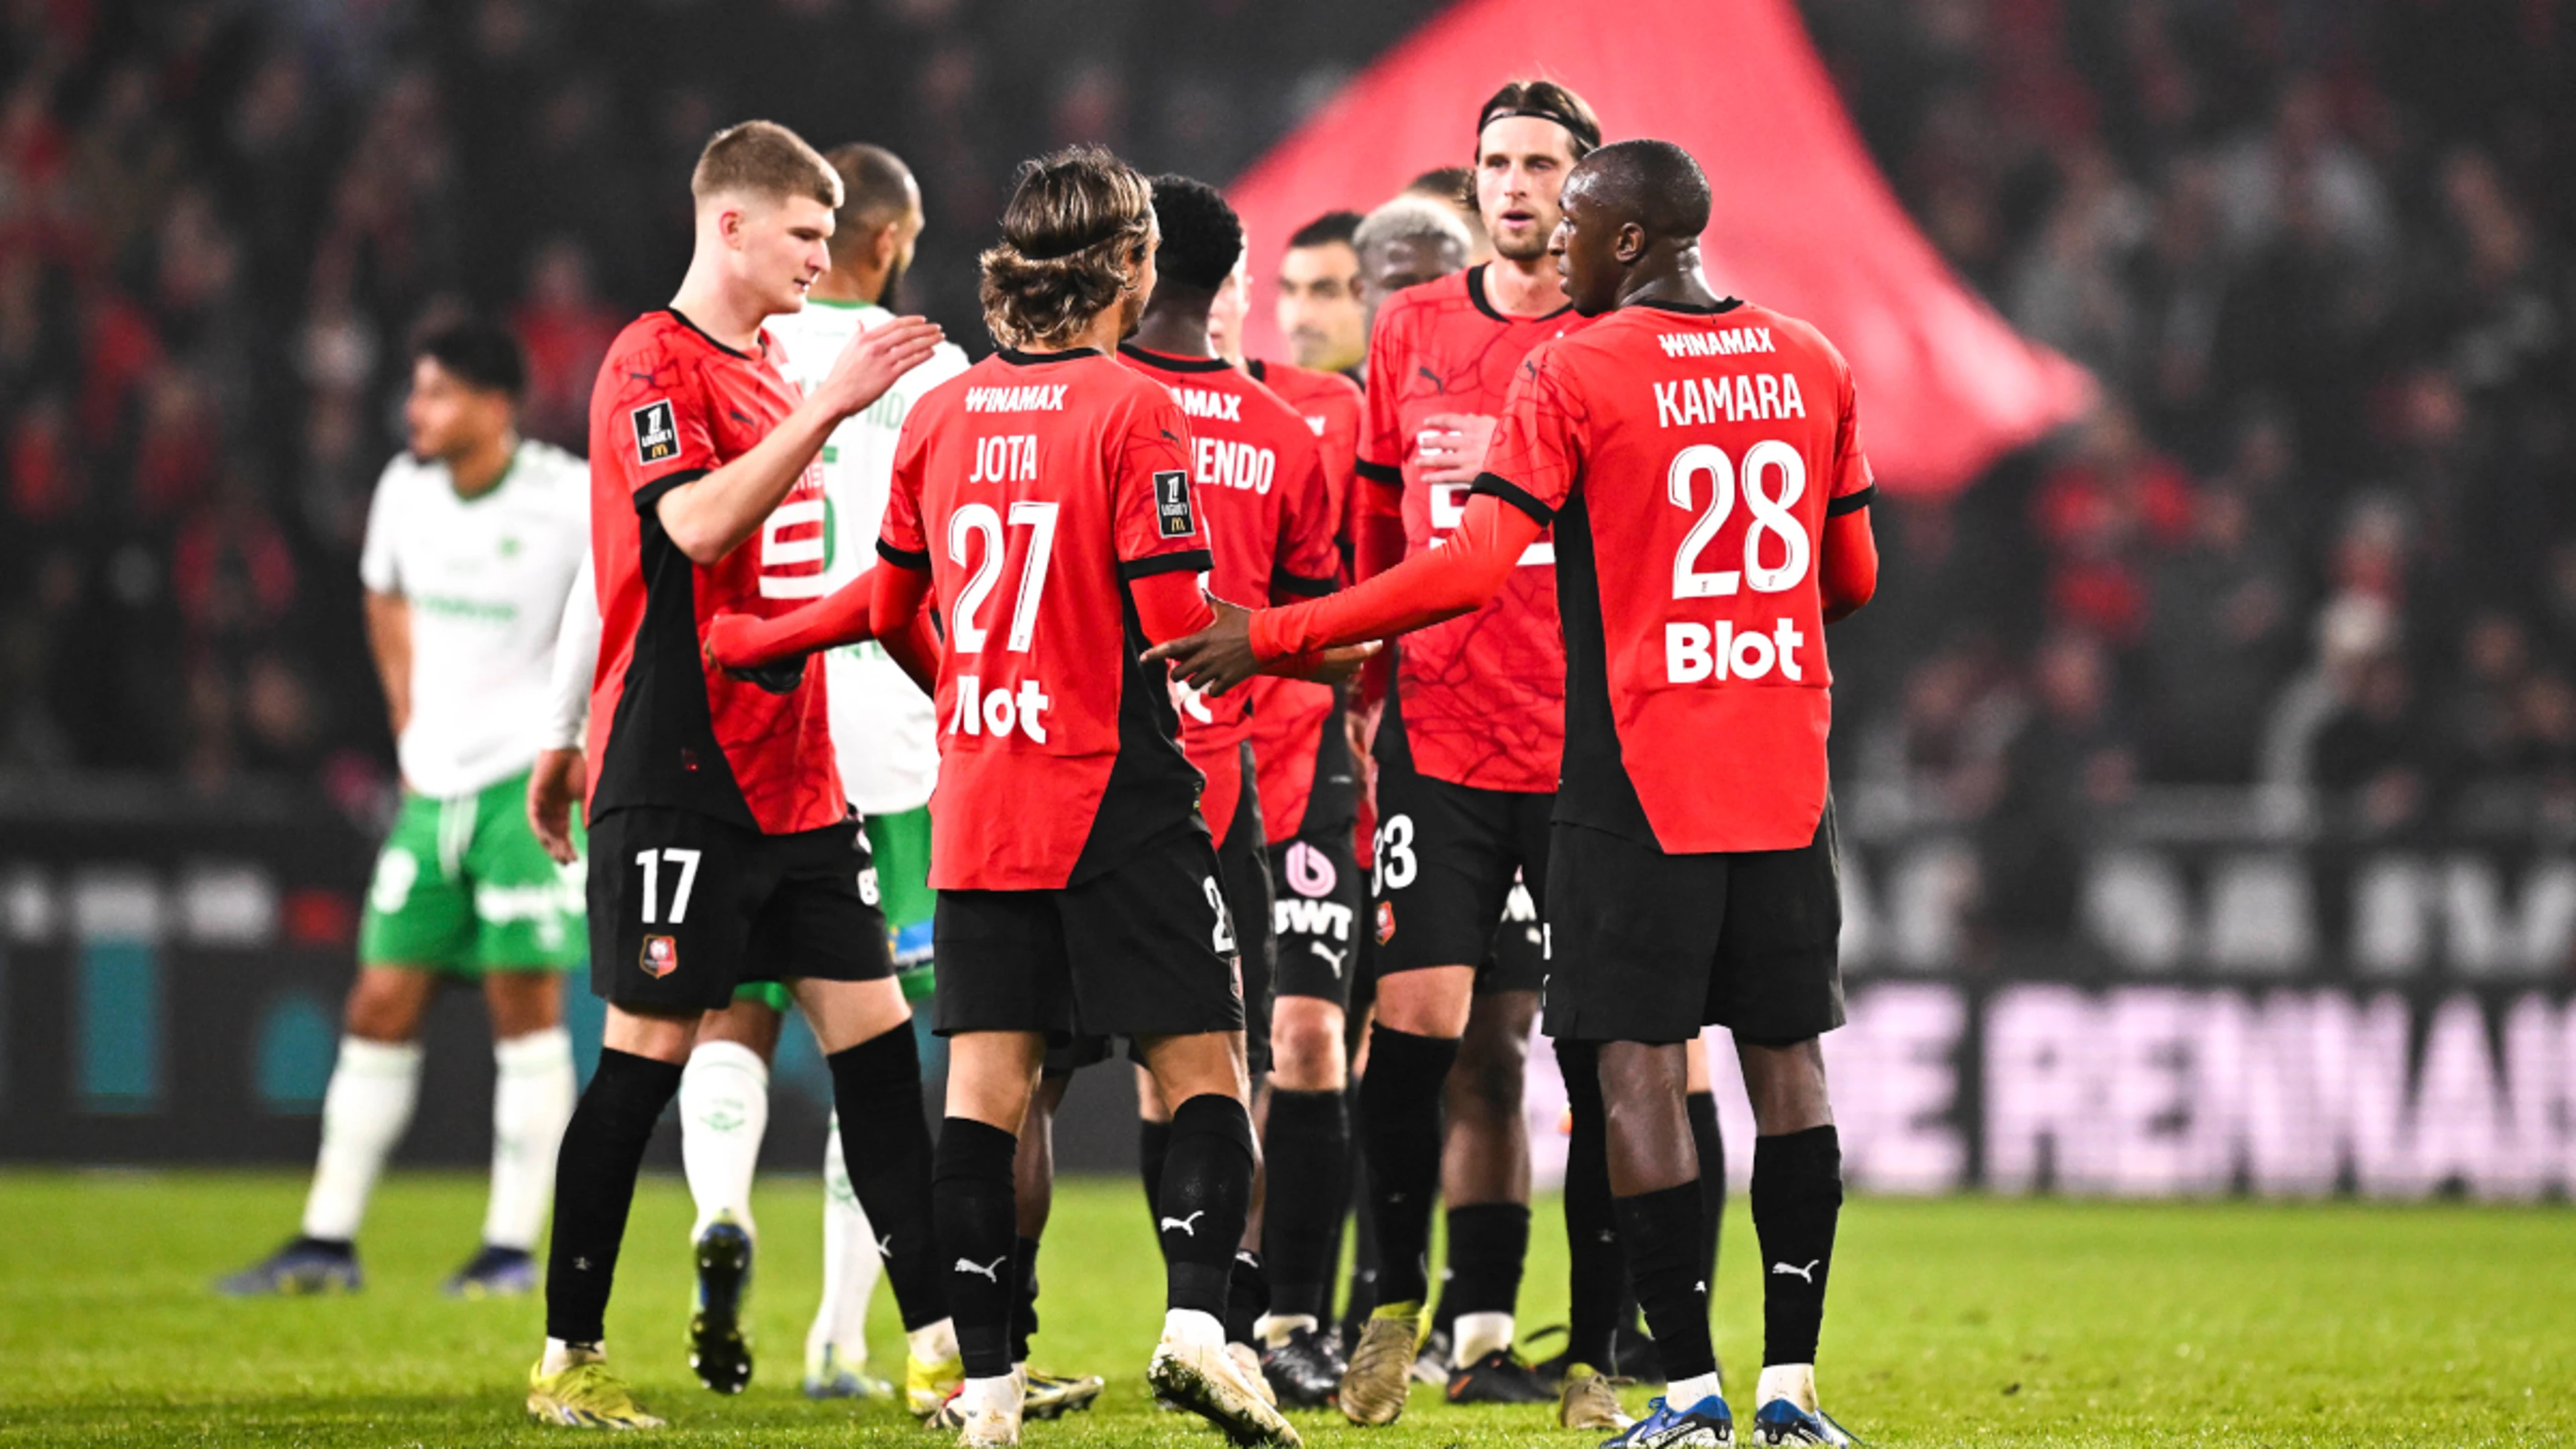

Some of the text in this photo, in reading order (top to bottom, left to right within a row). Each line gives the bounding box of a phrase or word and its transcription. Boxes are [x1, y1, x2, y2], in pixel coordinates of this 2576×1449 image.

[1657, 328, 1776, 357] WINAMAX
[965, 384, 1069, 413] WINAMAX
[1653, 373, 1806, 428] KAMARA
[969, 434, 1037, 483] JOTA
[1191, 437, 1275, 494] ENDO
[1668, 440, 1810, 599] 28
[948, 500, 1059, 653] 27
[1666, 618, 1803, 683] Blot
[635, 847, 702, 924] 17
